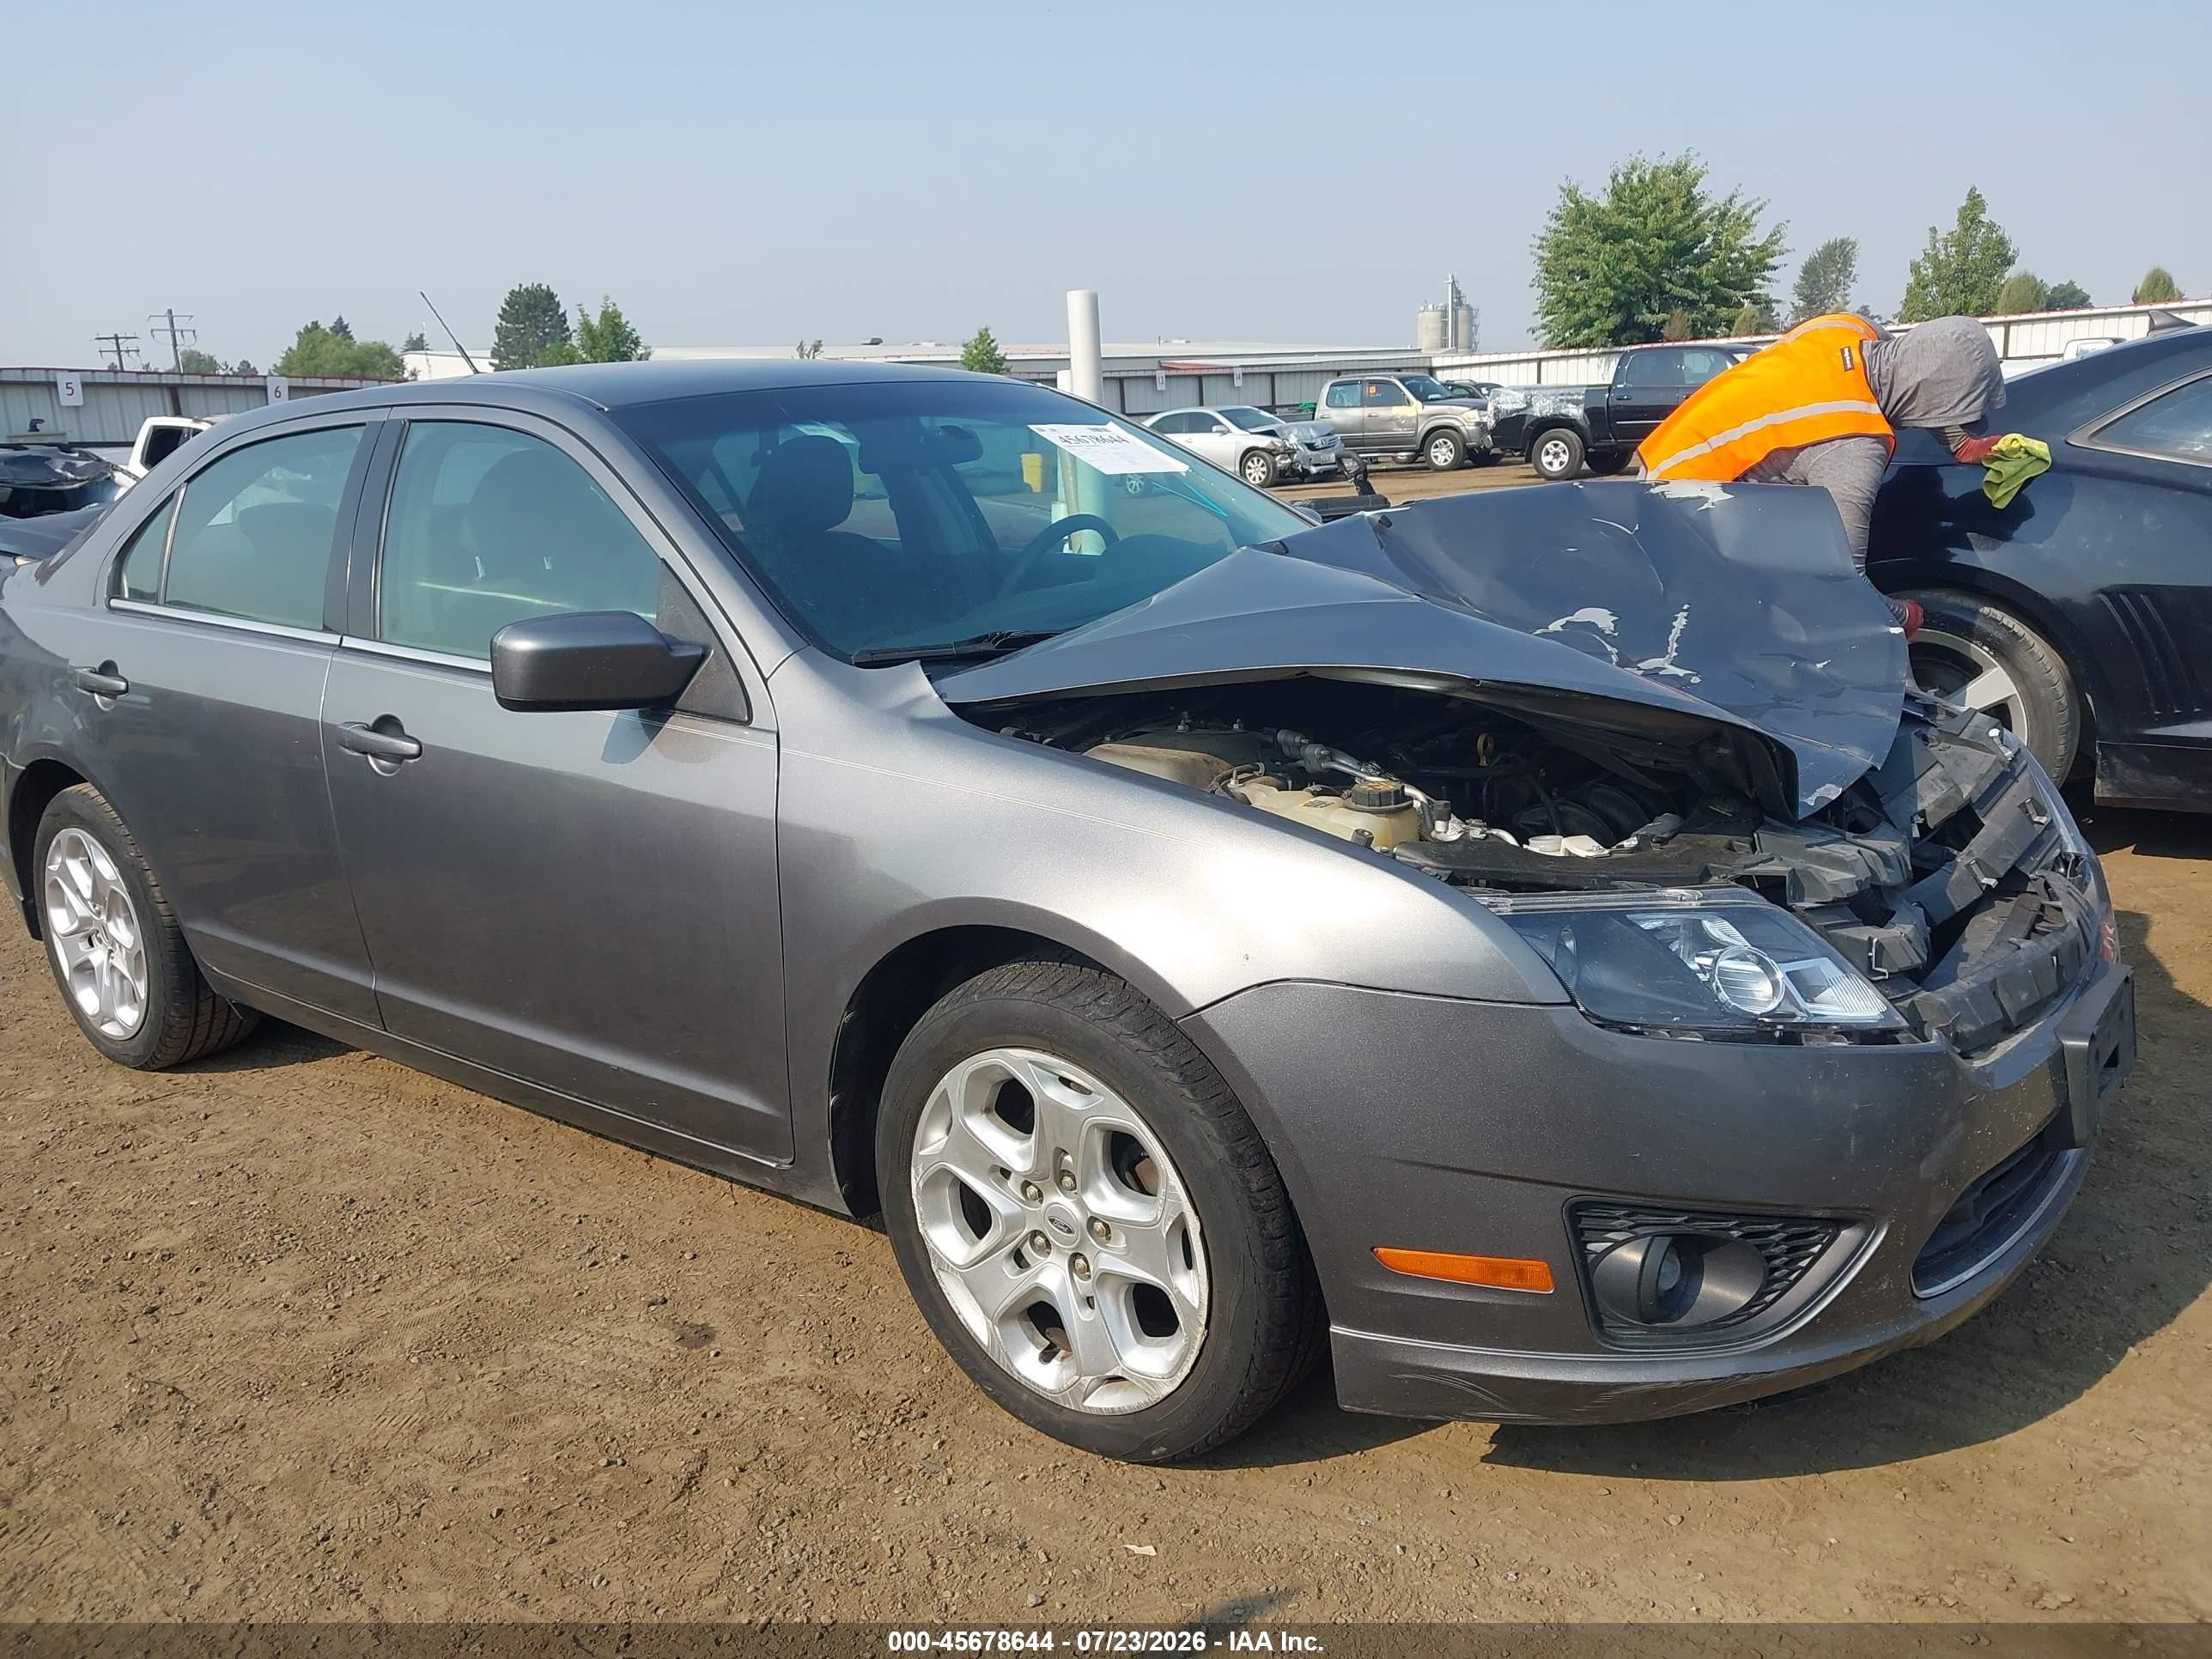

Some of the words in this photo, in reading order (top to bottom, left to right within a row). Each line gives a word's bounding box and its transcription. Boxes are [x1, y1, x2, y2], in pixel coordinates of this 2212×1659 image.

[65, 381, 75, 397] 5
[274, 386, 282, 399] 6
[1058, 434, 1131, 445] 45678644
